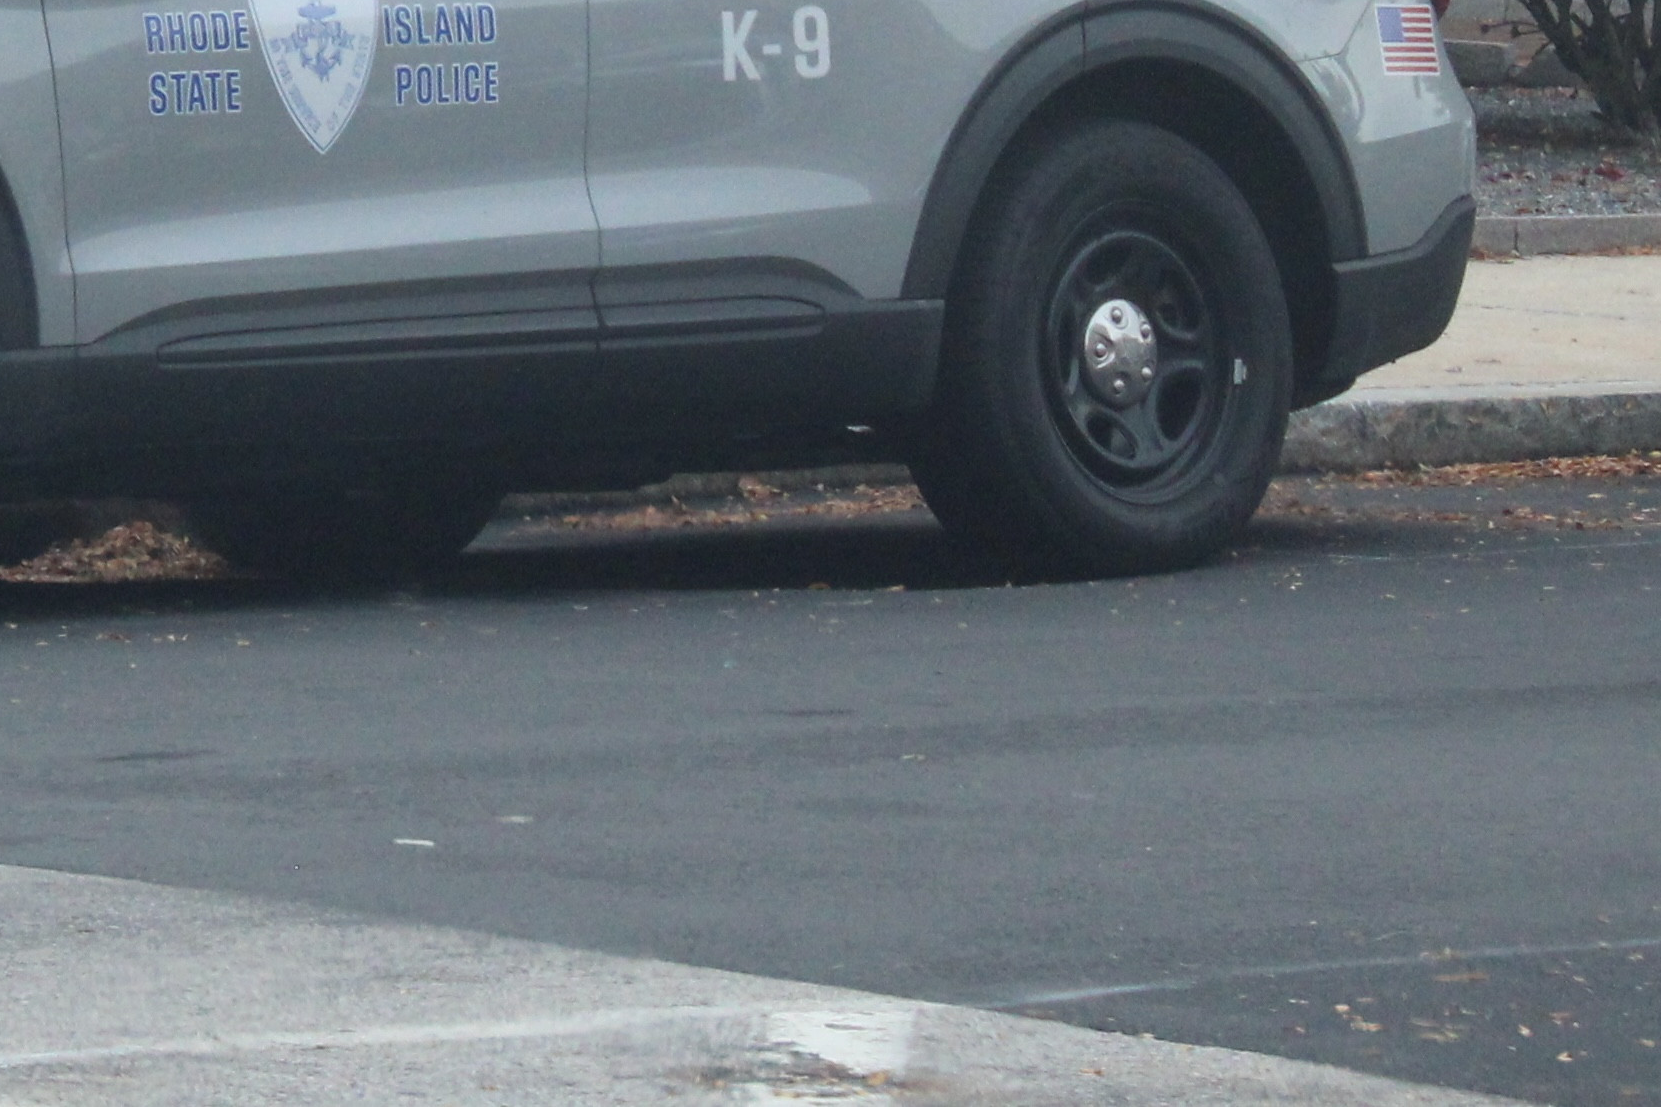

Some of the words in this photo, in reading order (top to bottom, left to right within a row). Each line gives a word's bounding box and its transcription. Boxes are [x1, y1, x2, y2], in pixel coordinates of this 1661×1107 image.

[143, 10, 250, 53] RHODE
[383, 3, 496, 46] ISLAND
[721, 5, 831, 81] K-9
[149, 70, 242, 115] STATE
[395, 62, 499, 105] POLICE
